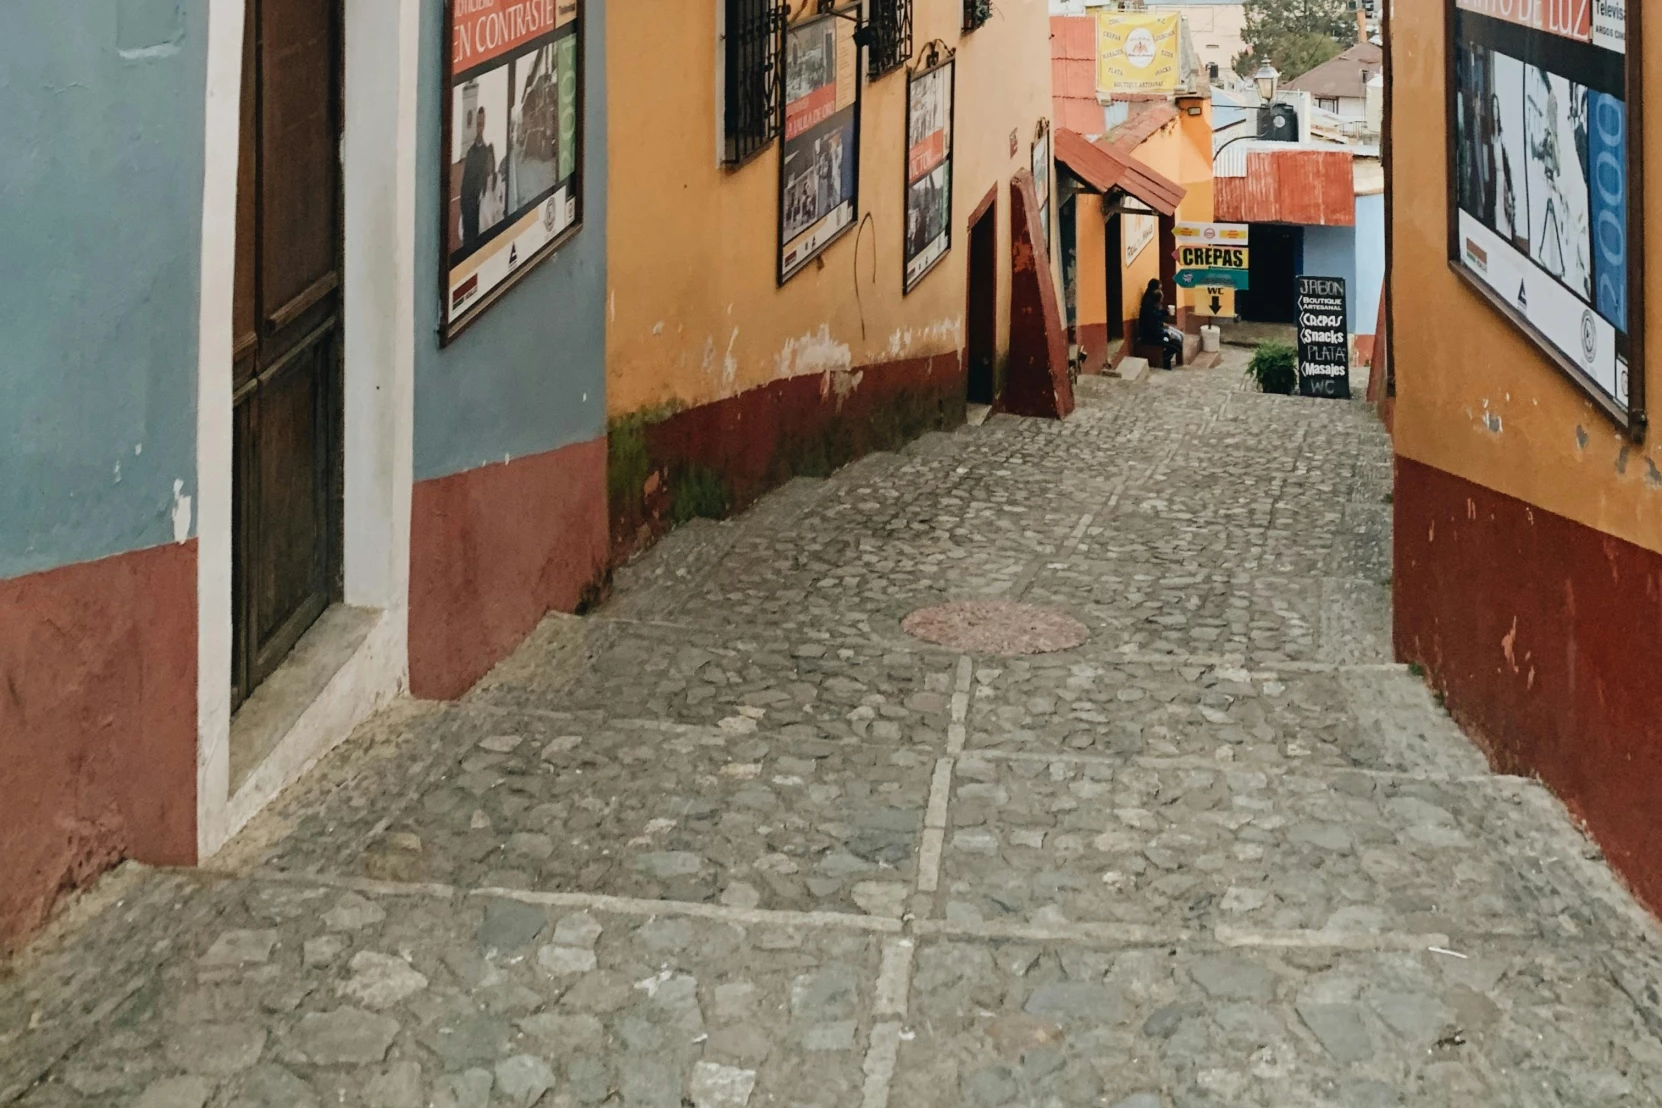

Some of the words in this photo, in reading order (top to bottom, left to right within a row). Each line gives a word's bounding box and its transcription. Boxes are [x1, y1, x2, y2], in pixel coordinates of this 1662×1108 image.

[1596, 93, 1625, 330] 2000
[1182, 247, 1243, 267] CREPAS
[1207, 286, 1225, 295] WC
[1300, 278, 1344, 296] JABON
[1302, 296, 1343, 305] BOUTIQUE
[1302, 303, 1343, 311] ARTESANAL
[1304, 329, 1345, 344] Snacks
[1307, 345, 1346, 362] PLATA
[1305, 362, 1346, 378] Masajes
[1310, 379, 1335, 395] WC
